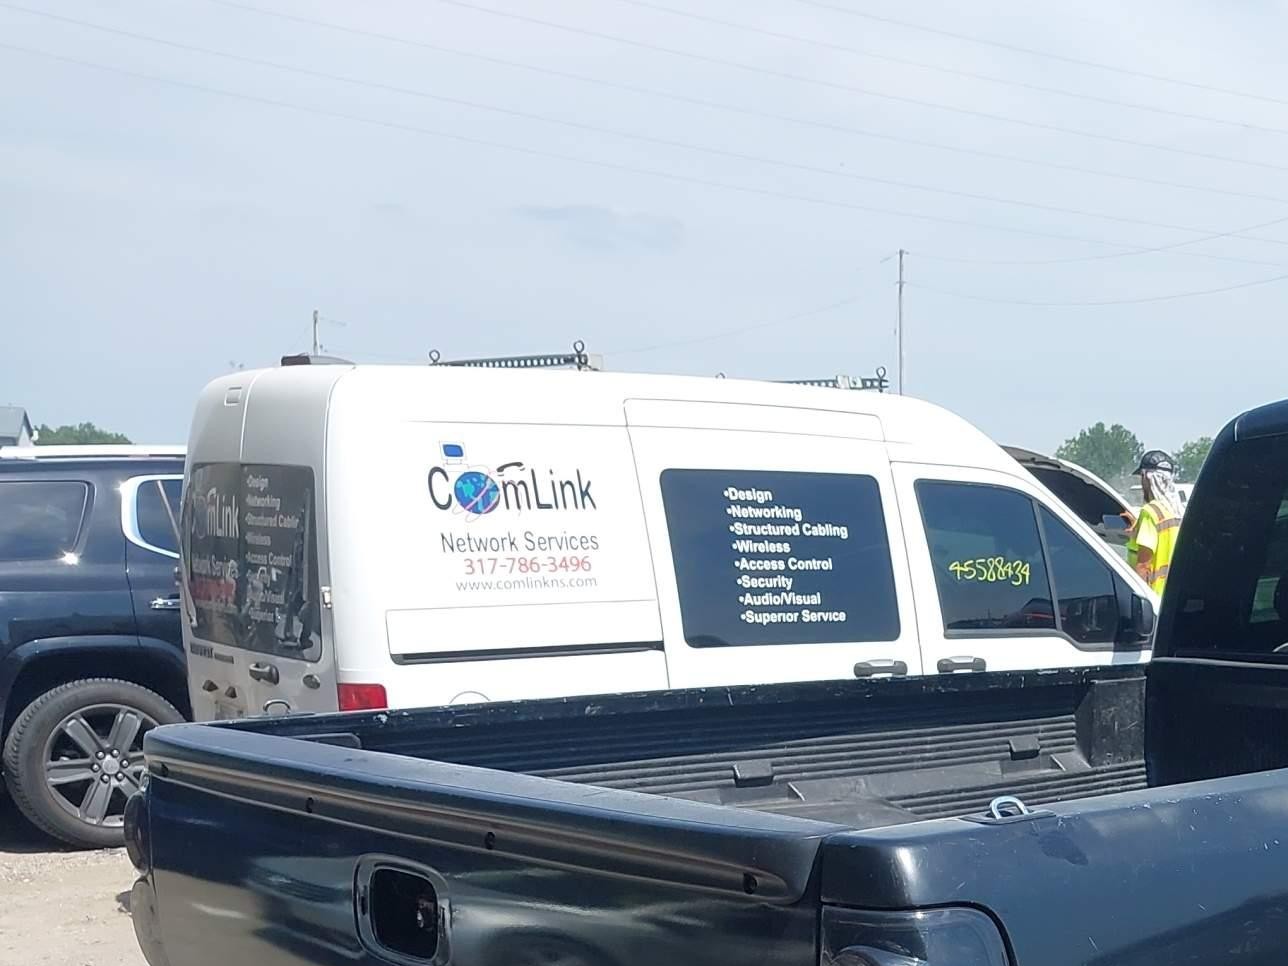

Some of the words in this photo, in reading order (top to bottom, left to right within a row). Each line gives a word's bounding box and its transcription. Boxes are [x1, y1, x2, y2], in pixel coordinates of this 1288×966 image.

[427, 464, 597, 515] ComLink
[727, 487, 773, 504] Design
[731, 504, 803, 522] Networking
[734, 521, 800, 537] Structured
[802, 522, 849, 539] Cabling
[441, 532, 519, 553] Network
[523, 530, 600, 551] Services
[736, 540, 791, 554] Wireless
[463, 555, 593, 576] 317-786-3496
[739, 557, 786, 571] Access
[788, 557, 833, 571] Control
[948, 556, 1031, 586] 45588434
[455, 575, 598, 592] www.comlinkns.com
[741, 574, 793, 591] Security
[744, 592, 821, 606] Audio/Visual
[745, 609, 799, 625] Superior
[801, 609, 847, 623] Service
